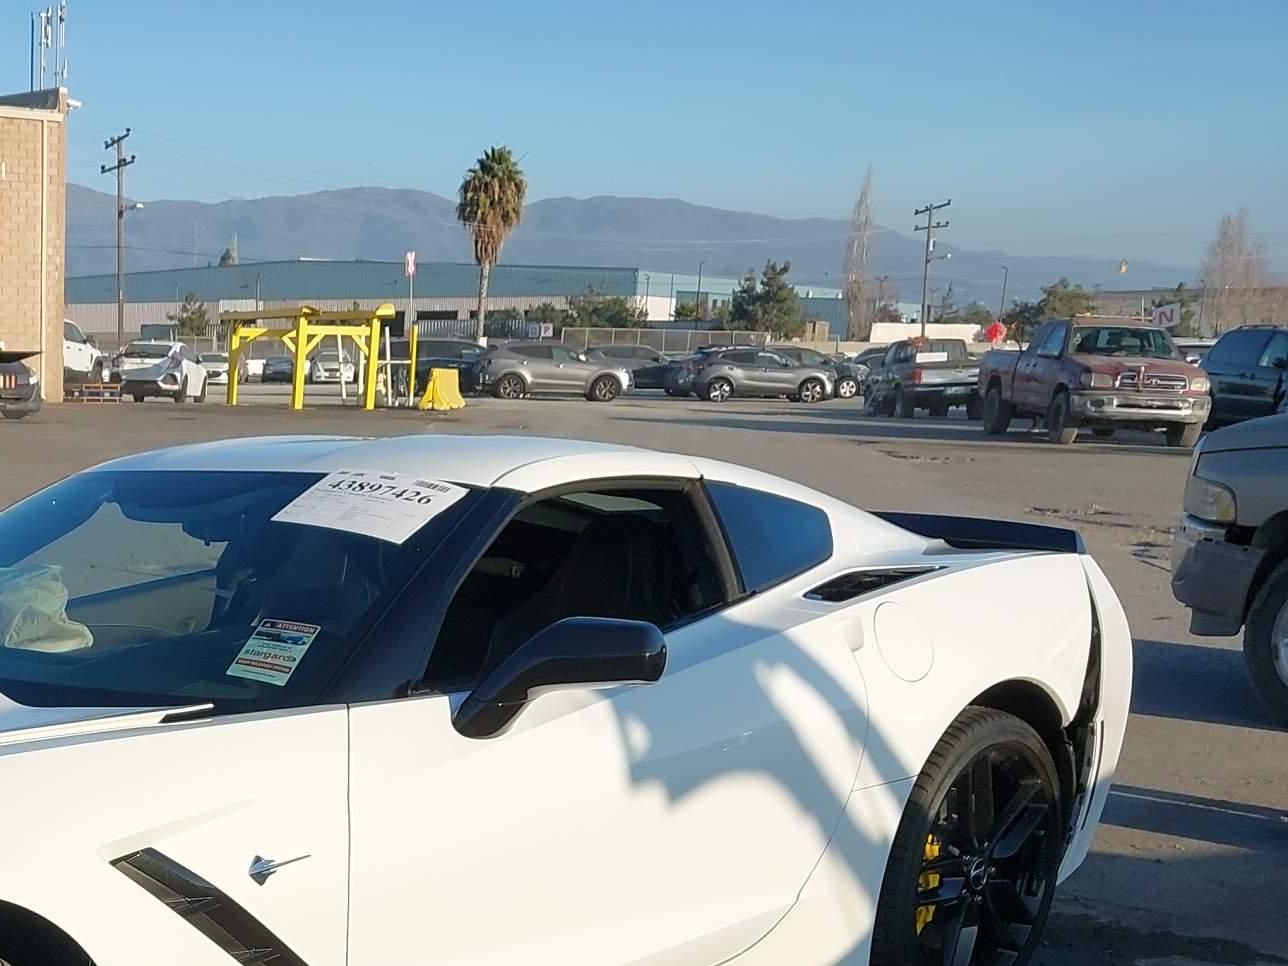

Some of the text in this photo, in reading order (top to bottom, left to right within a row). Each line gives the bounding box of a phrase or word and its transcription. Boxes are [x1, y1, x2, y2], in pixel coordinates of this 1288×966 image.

[1158, 308, 1174, 324] N
[544, 326, 550, 335] P
[327, 479, 432, 505] 43897426
[277, 623, 317, 634] ATTENTION
